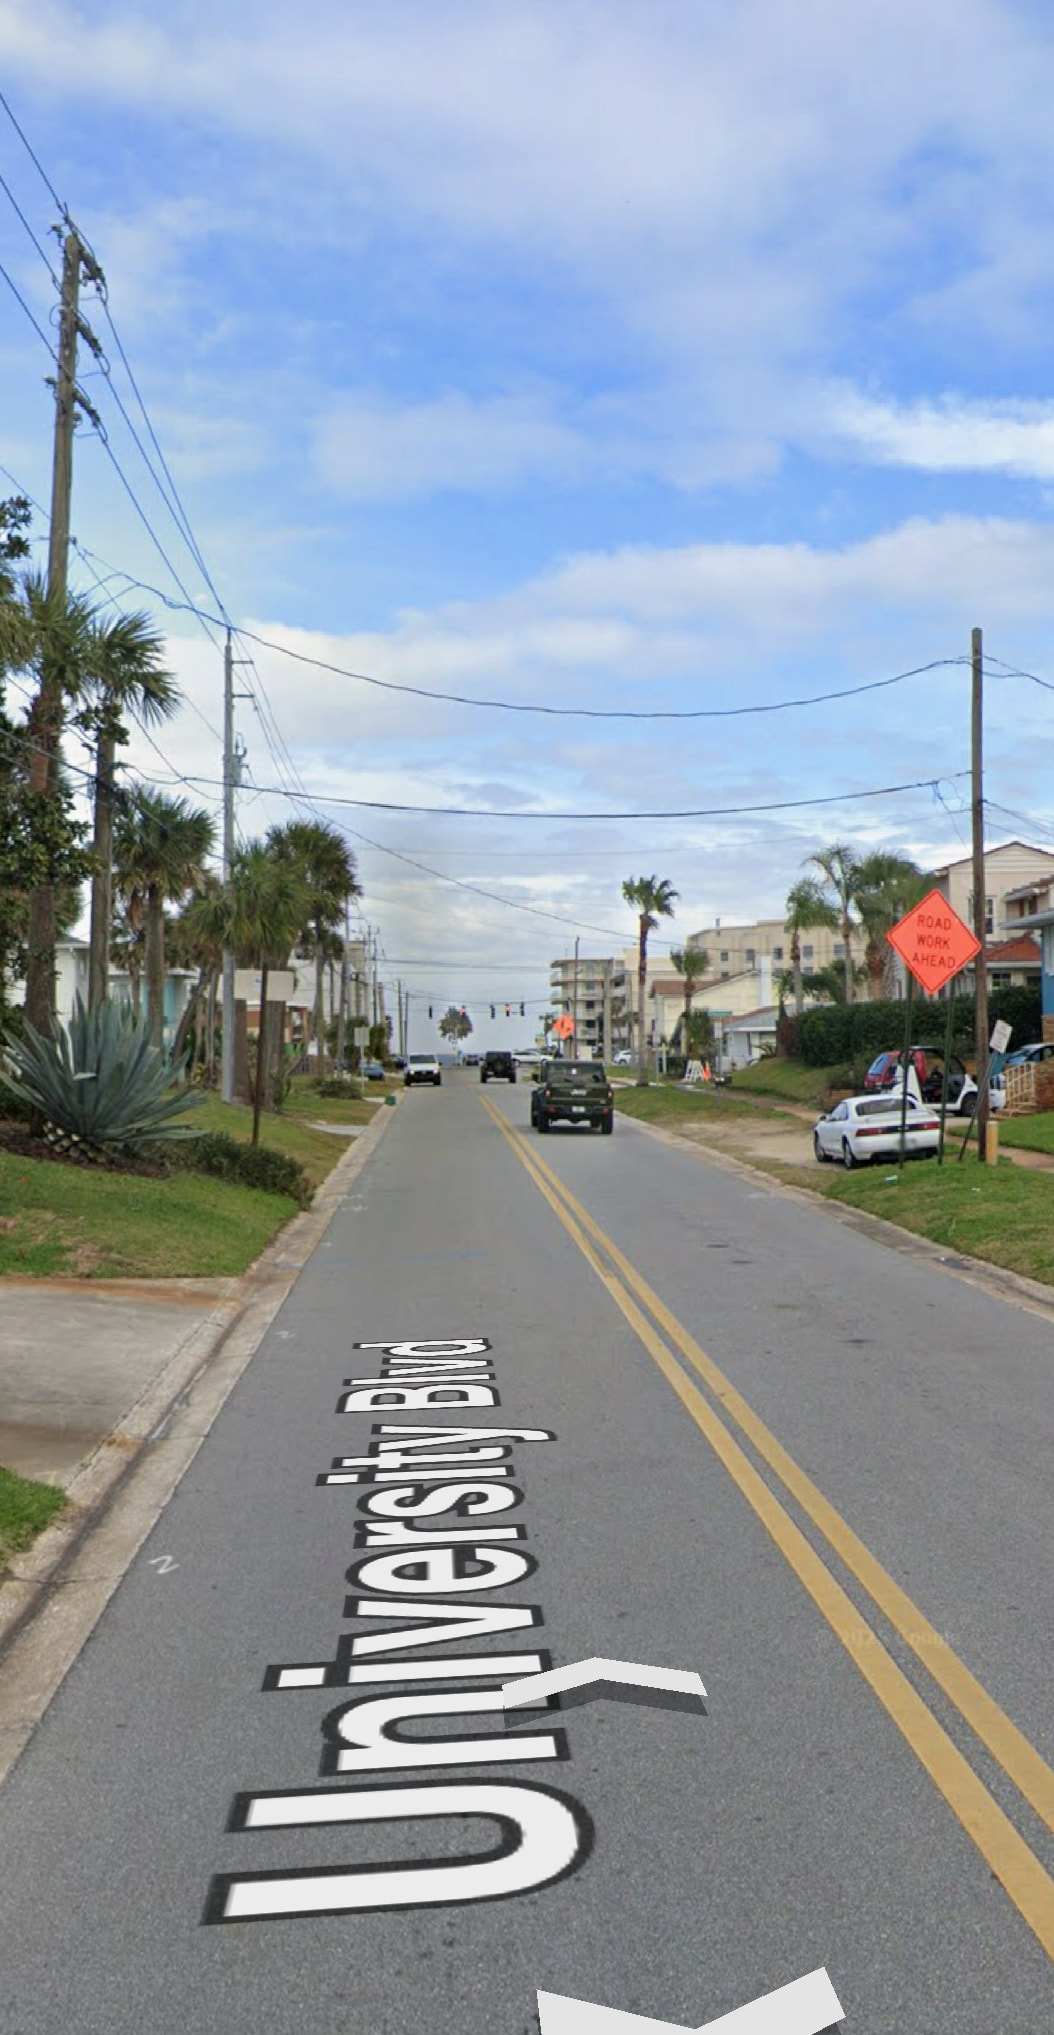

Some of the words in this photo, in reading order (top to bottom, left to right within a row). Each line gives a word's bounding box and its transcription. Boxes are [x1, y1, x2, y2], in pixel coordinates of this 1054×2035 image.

[917, 915, 951, 931] ROAD
[917, 934, 951, 950] WORK
[912, 952, 956, 969] AHEAD
